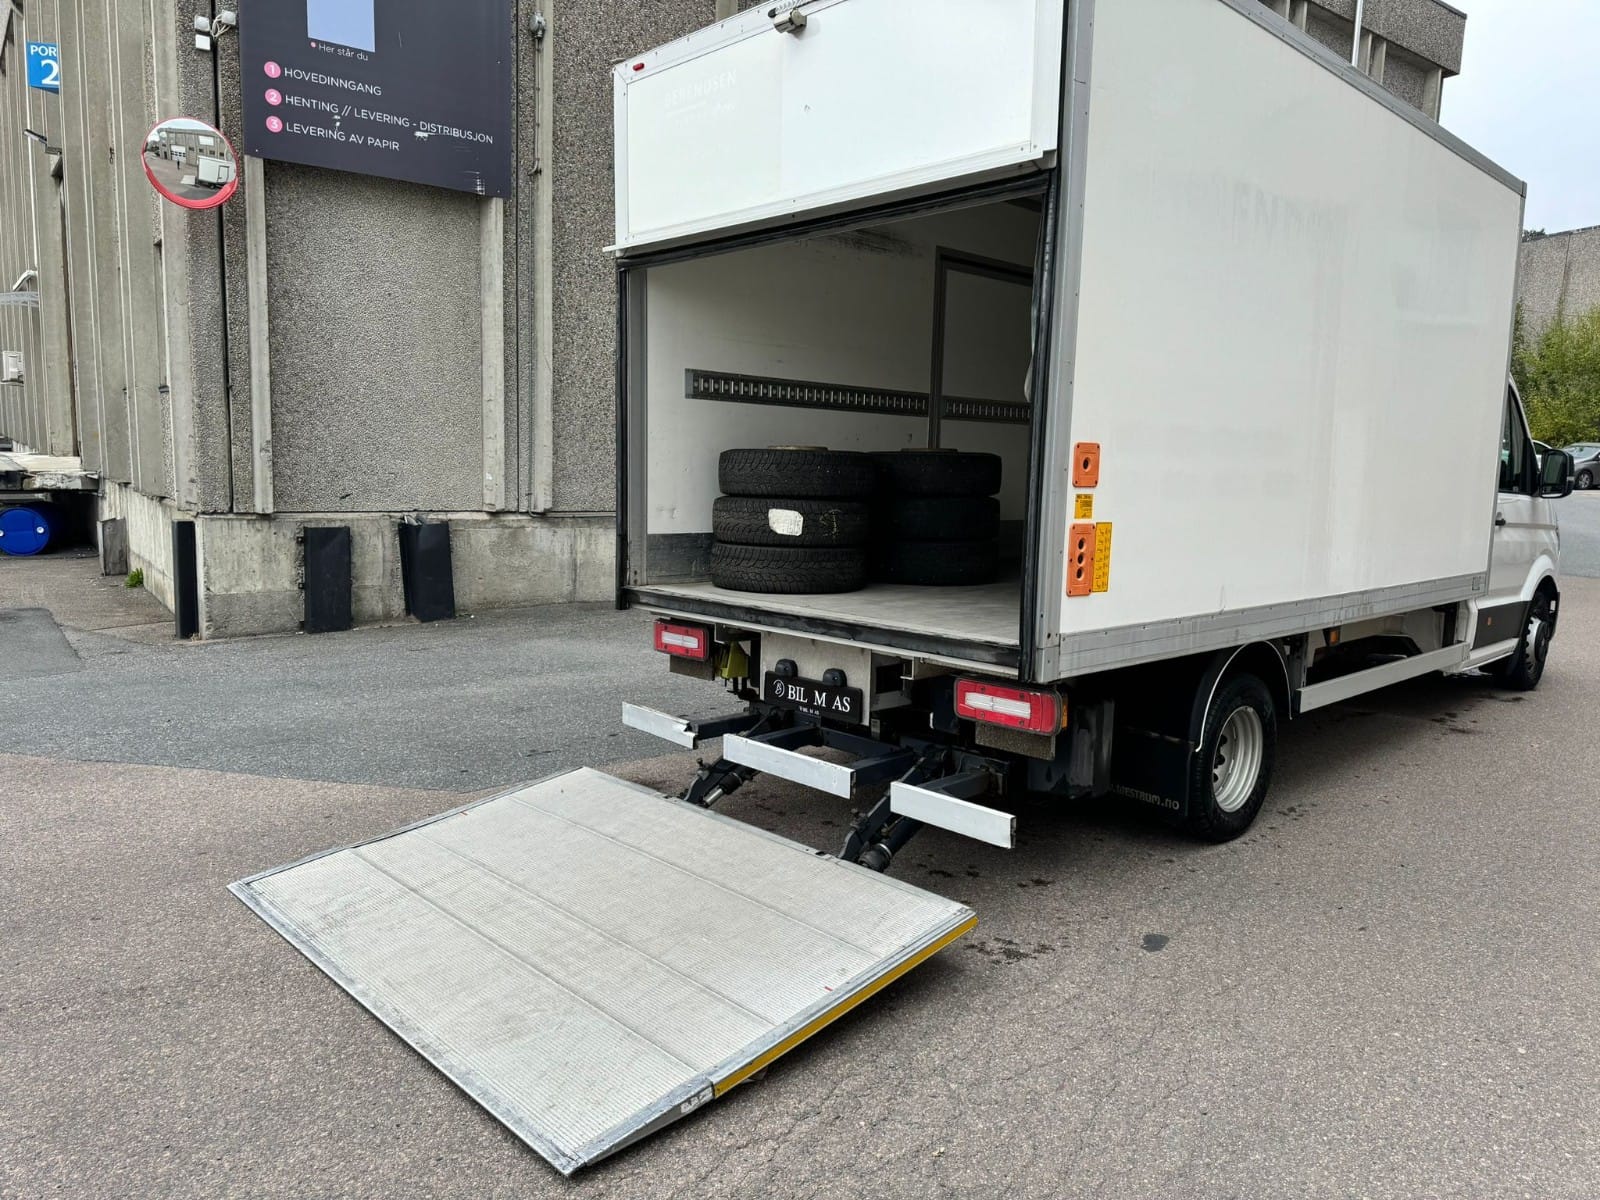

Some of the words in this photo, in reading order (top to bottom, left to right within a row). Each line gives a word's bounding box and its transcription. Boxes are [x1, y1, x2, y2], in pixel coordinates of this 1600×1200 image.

[30, 45, 57, 57] POR
[318, 44, 334, 54] Her
[337, 48, 355, 58] står
[356, 52, 369, 61] du
[41, 59, 60, 85] 2
[284, 67, 382, 96] HOVEDINNGANG
[285, 95, 339, 113] HENTING
[354, 107, 410, 127] LEVERING
[419, 121, 494, 144] DISTRIBUSJON
[286, 122, 346, 141] LEVERING
[349, 133, 364, 144] AV
[367, 137, 400, 151] PAPIR
[787, 684, 808, 703] BIL
[813, 690, 827, 708] M
[832, 695, 851, 713] AS
